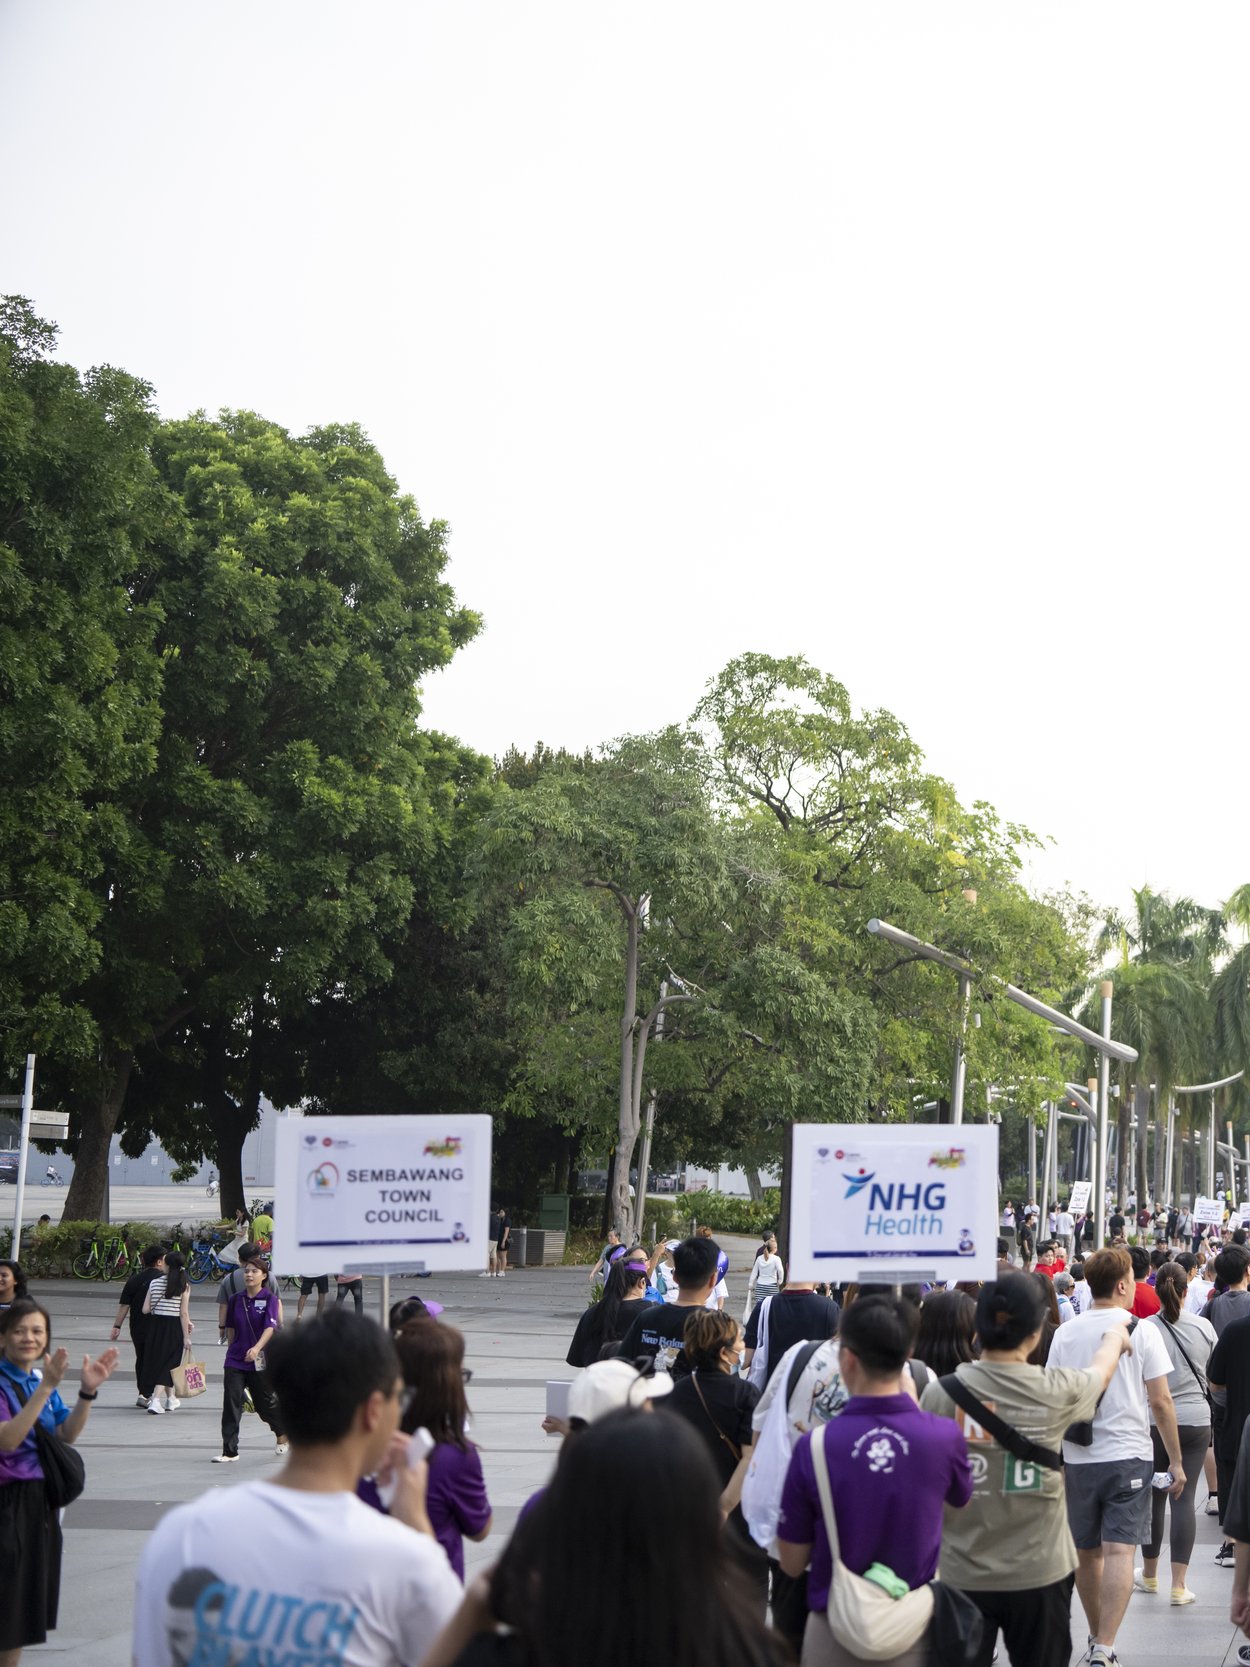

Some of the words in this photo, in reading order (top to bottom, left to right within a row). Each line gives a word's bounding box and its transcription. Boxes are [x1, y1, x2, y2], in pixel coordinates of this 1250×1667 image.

[346, 1168, 464, 1182] SEMBAWANG
[379, 1189, 432, 1203] TOWN
[868, 1183, 946, 1211] NHG
[364, 1209, 444, 1223] COUNCIL
[864, 1214, 943, 1236] Health
[194, 1582, 359, 1656] CLUTCH
